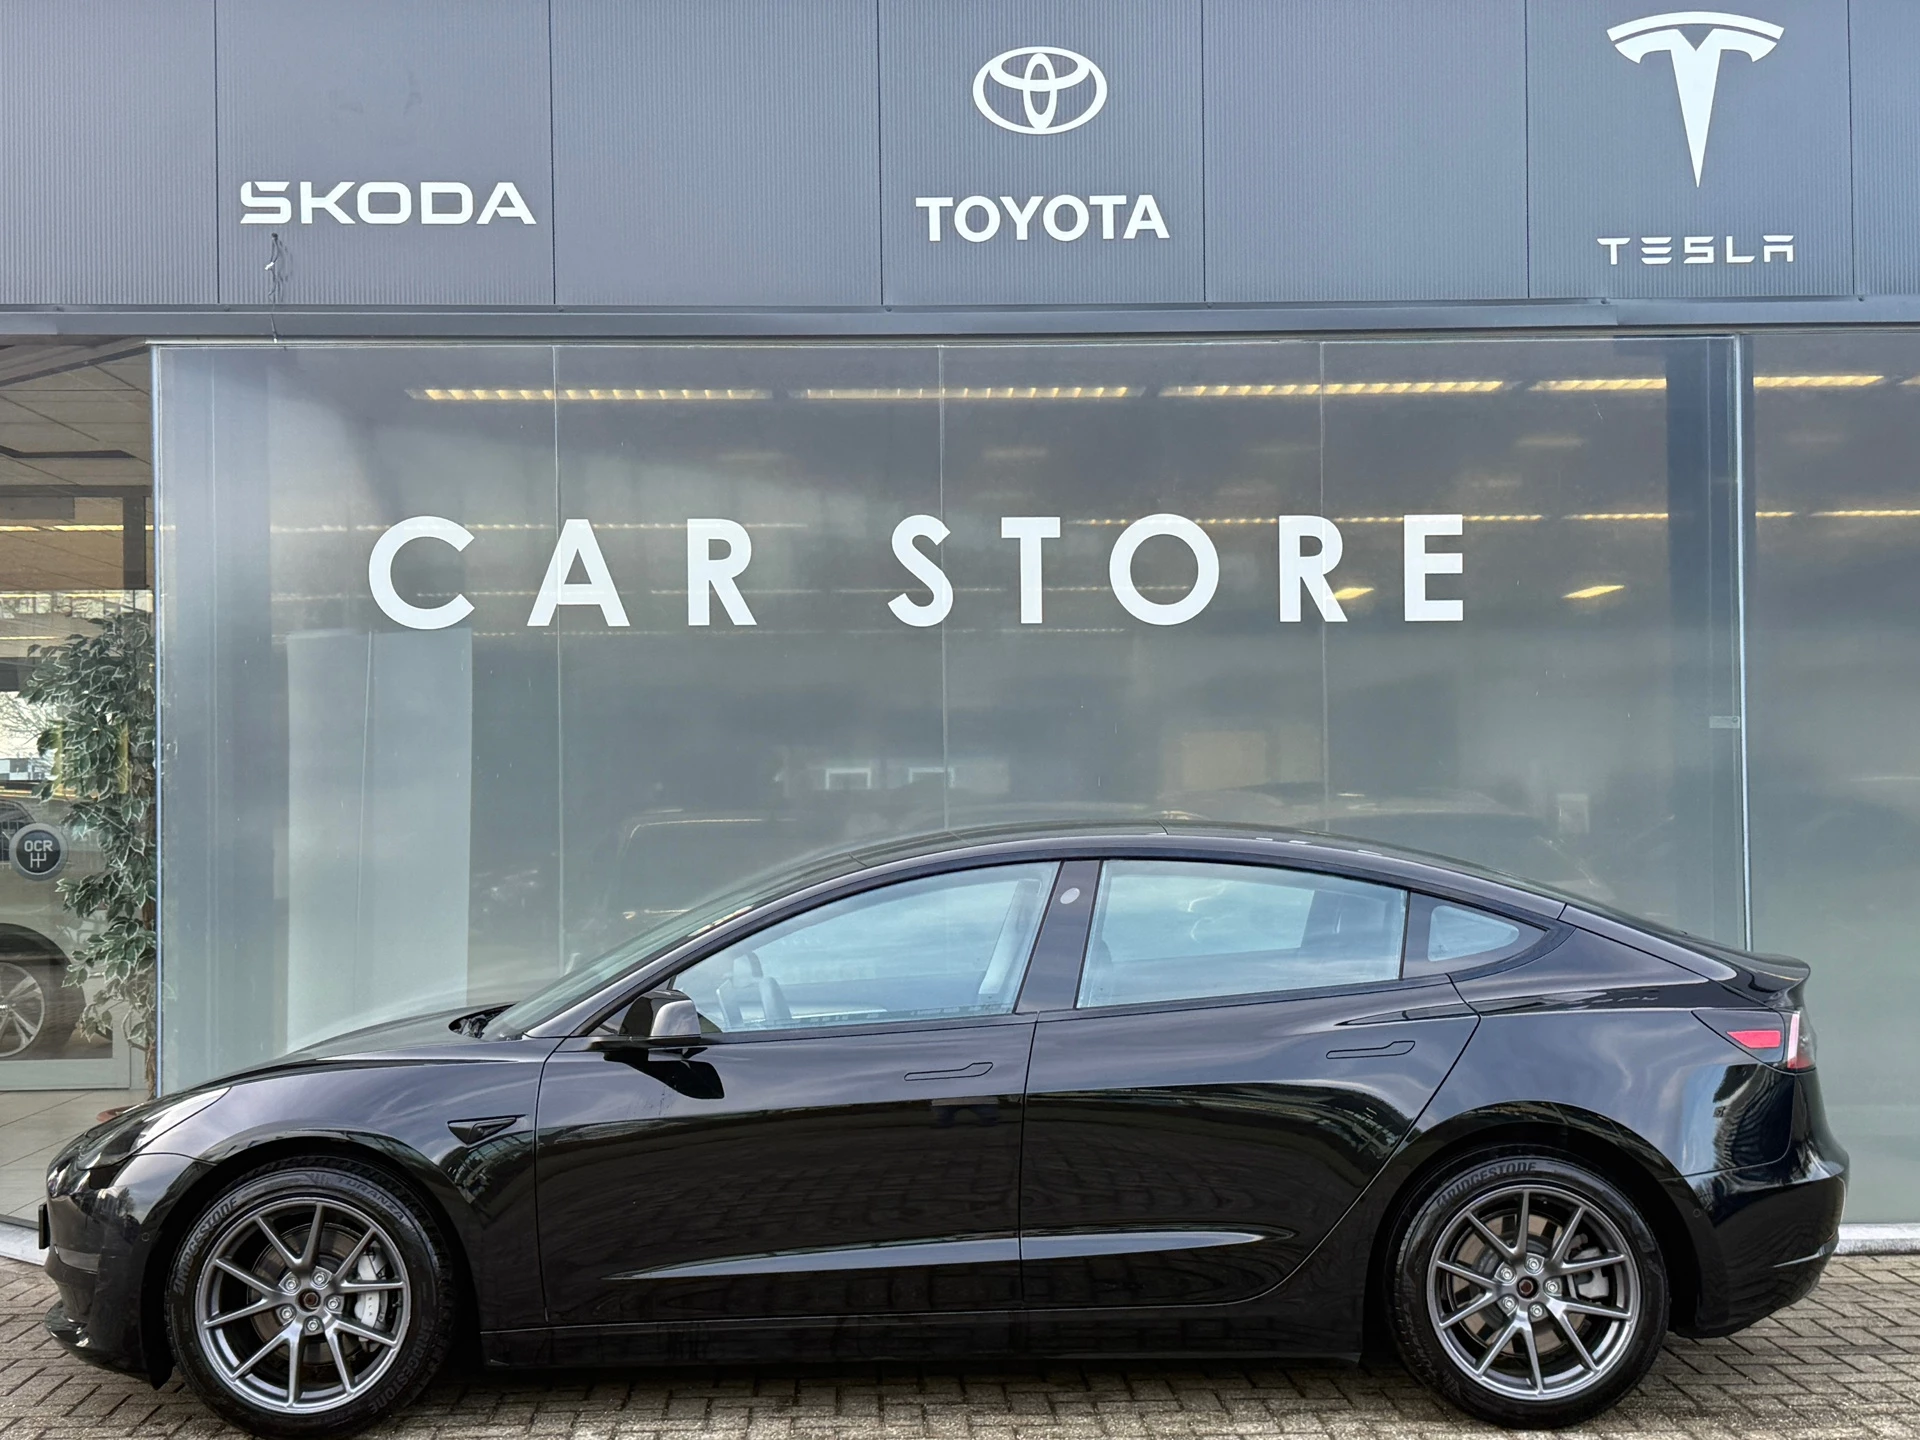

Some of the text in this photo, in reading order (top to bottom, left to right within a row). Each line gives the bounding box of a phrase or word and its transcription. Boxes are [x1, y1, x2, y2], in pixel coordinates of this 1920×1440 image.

[240, 181, 537, 226] SKODA
[916, 194, 1170, 243] TOYOTA
[1597, 235, 1795, 266] TESLA
[368, 513, 1465, 630] CAR STORE
[24, 839, 53, 853] OCR
